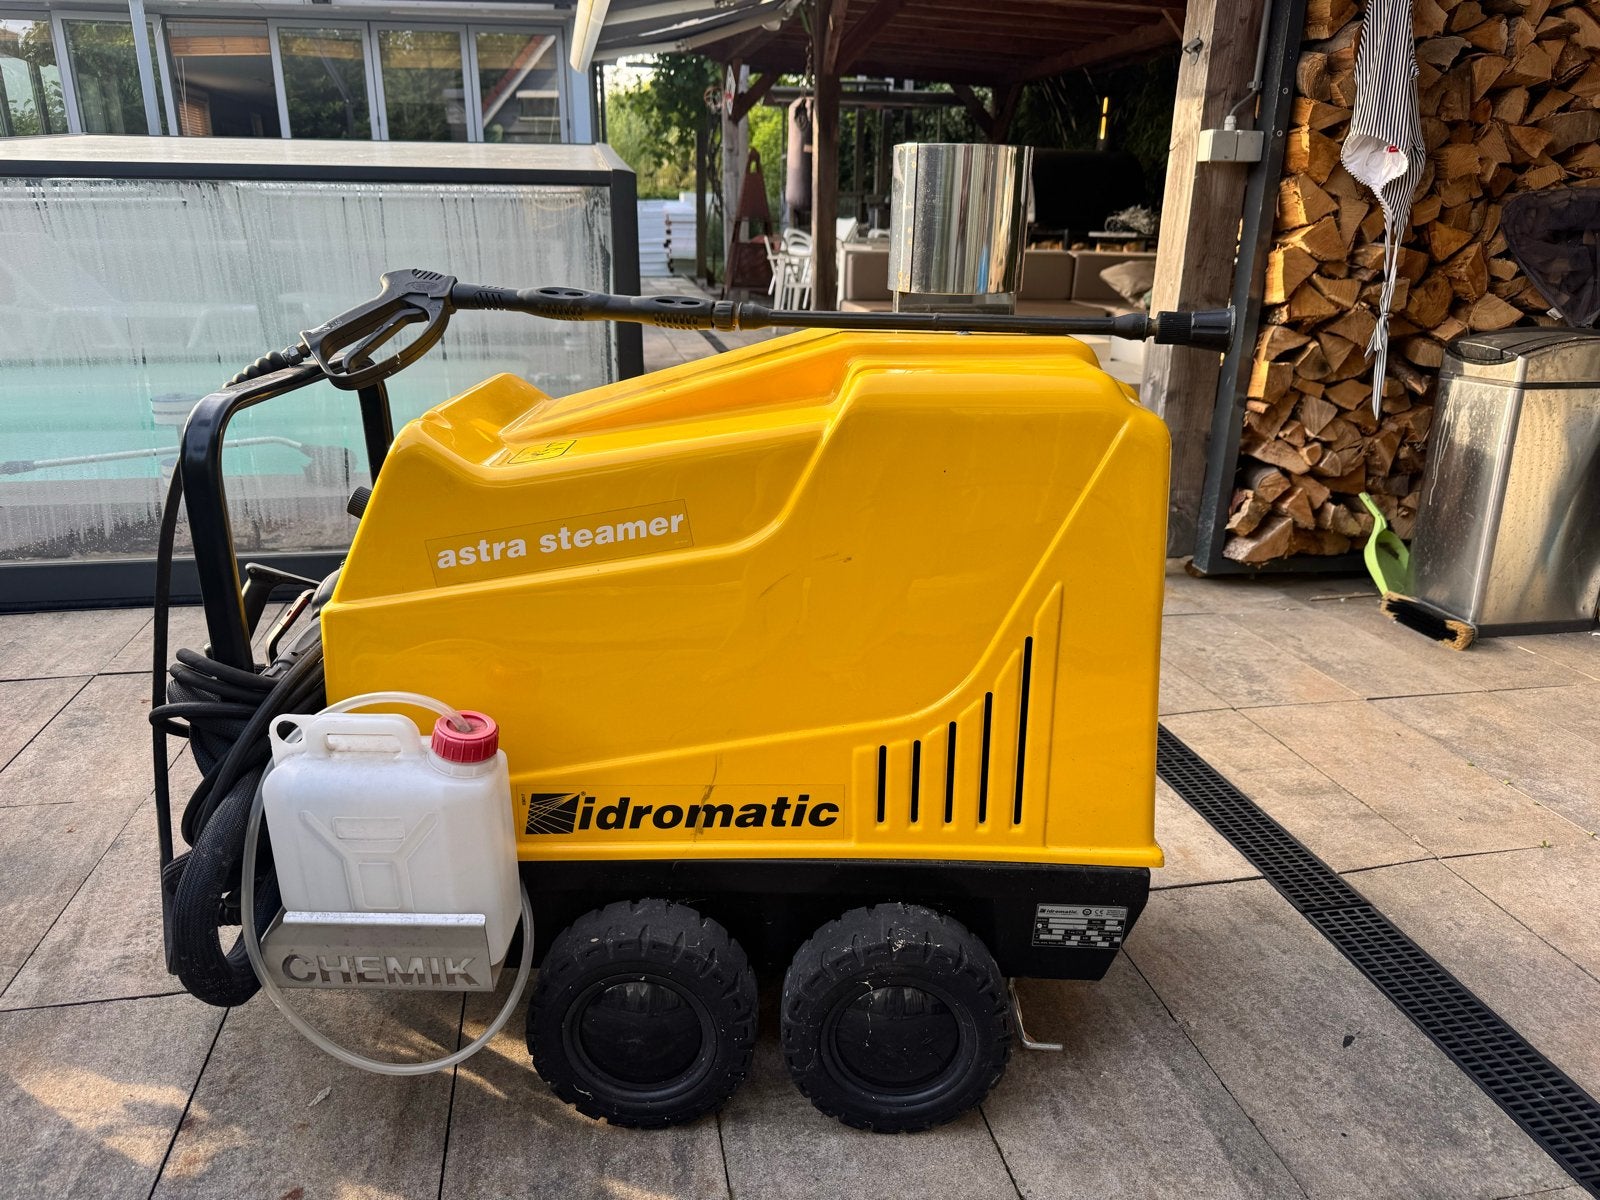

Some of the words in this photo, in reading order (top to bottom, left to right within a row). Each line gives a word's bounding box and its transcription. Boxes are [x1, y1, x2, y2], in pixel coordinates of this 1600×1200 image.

[437, 538, 527, 569] astra
[539, 513, 684, 553] steamer
[578, 794, 840, 830] idromatic
[282, 954, 480, 986] CHEMIK
